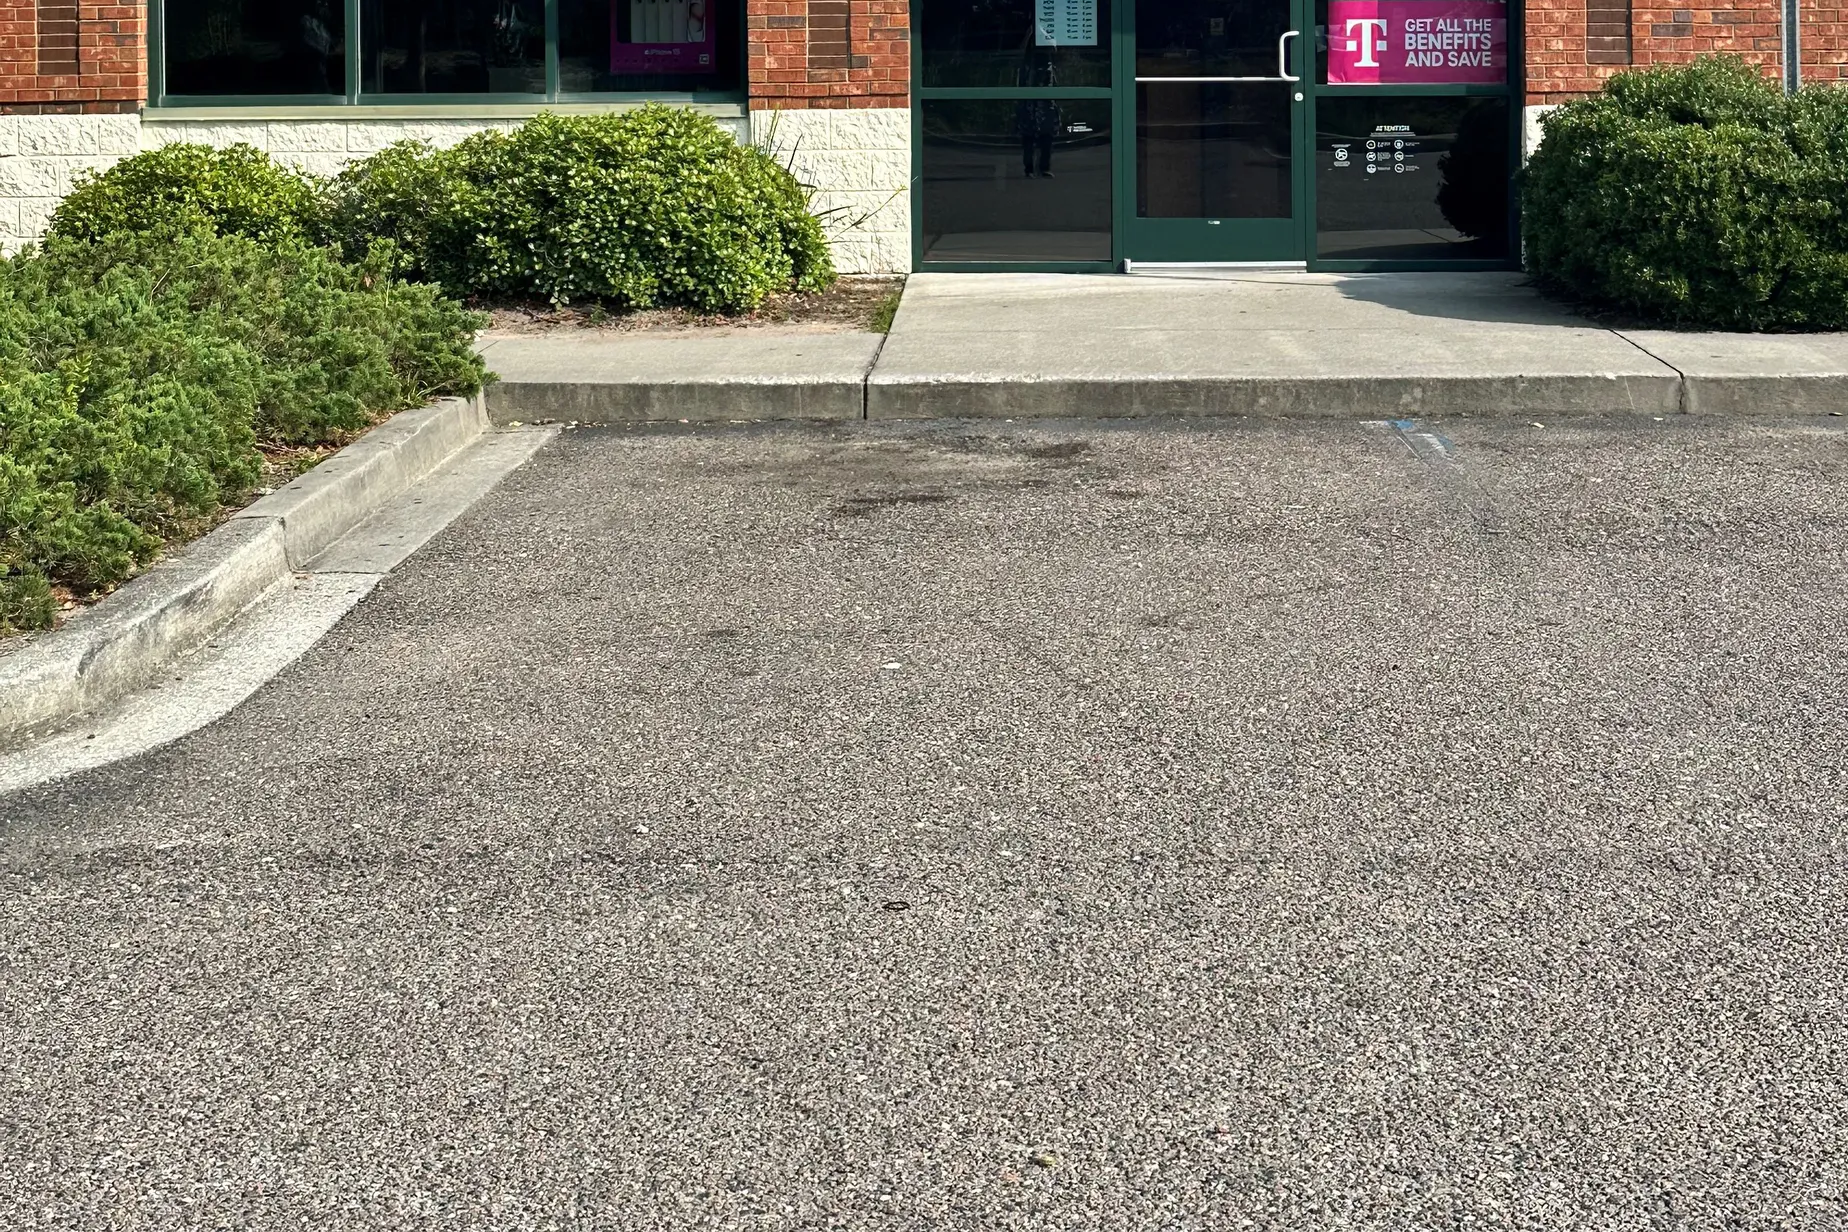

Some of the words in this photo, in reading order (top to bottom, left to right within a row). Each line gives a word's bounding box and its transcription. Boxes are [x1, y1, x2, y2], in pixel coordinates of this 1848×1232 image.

[1405, 19, 1432, 32] GET
[1435, 19, 1462, 32] ALL
[1464, 19, 1491, 31] THE
[1405, 33, 1491, 50] BENEFITS
[1405, 52, 1443, 67] AND
[1447, 52, 1491, 67] SAVE
